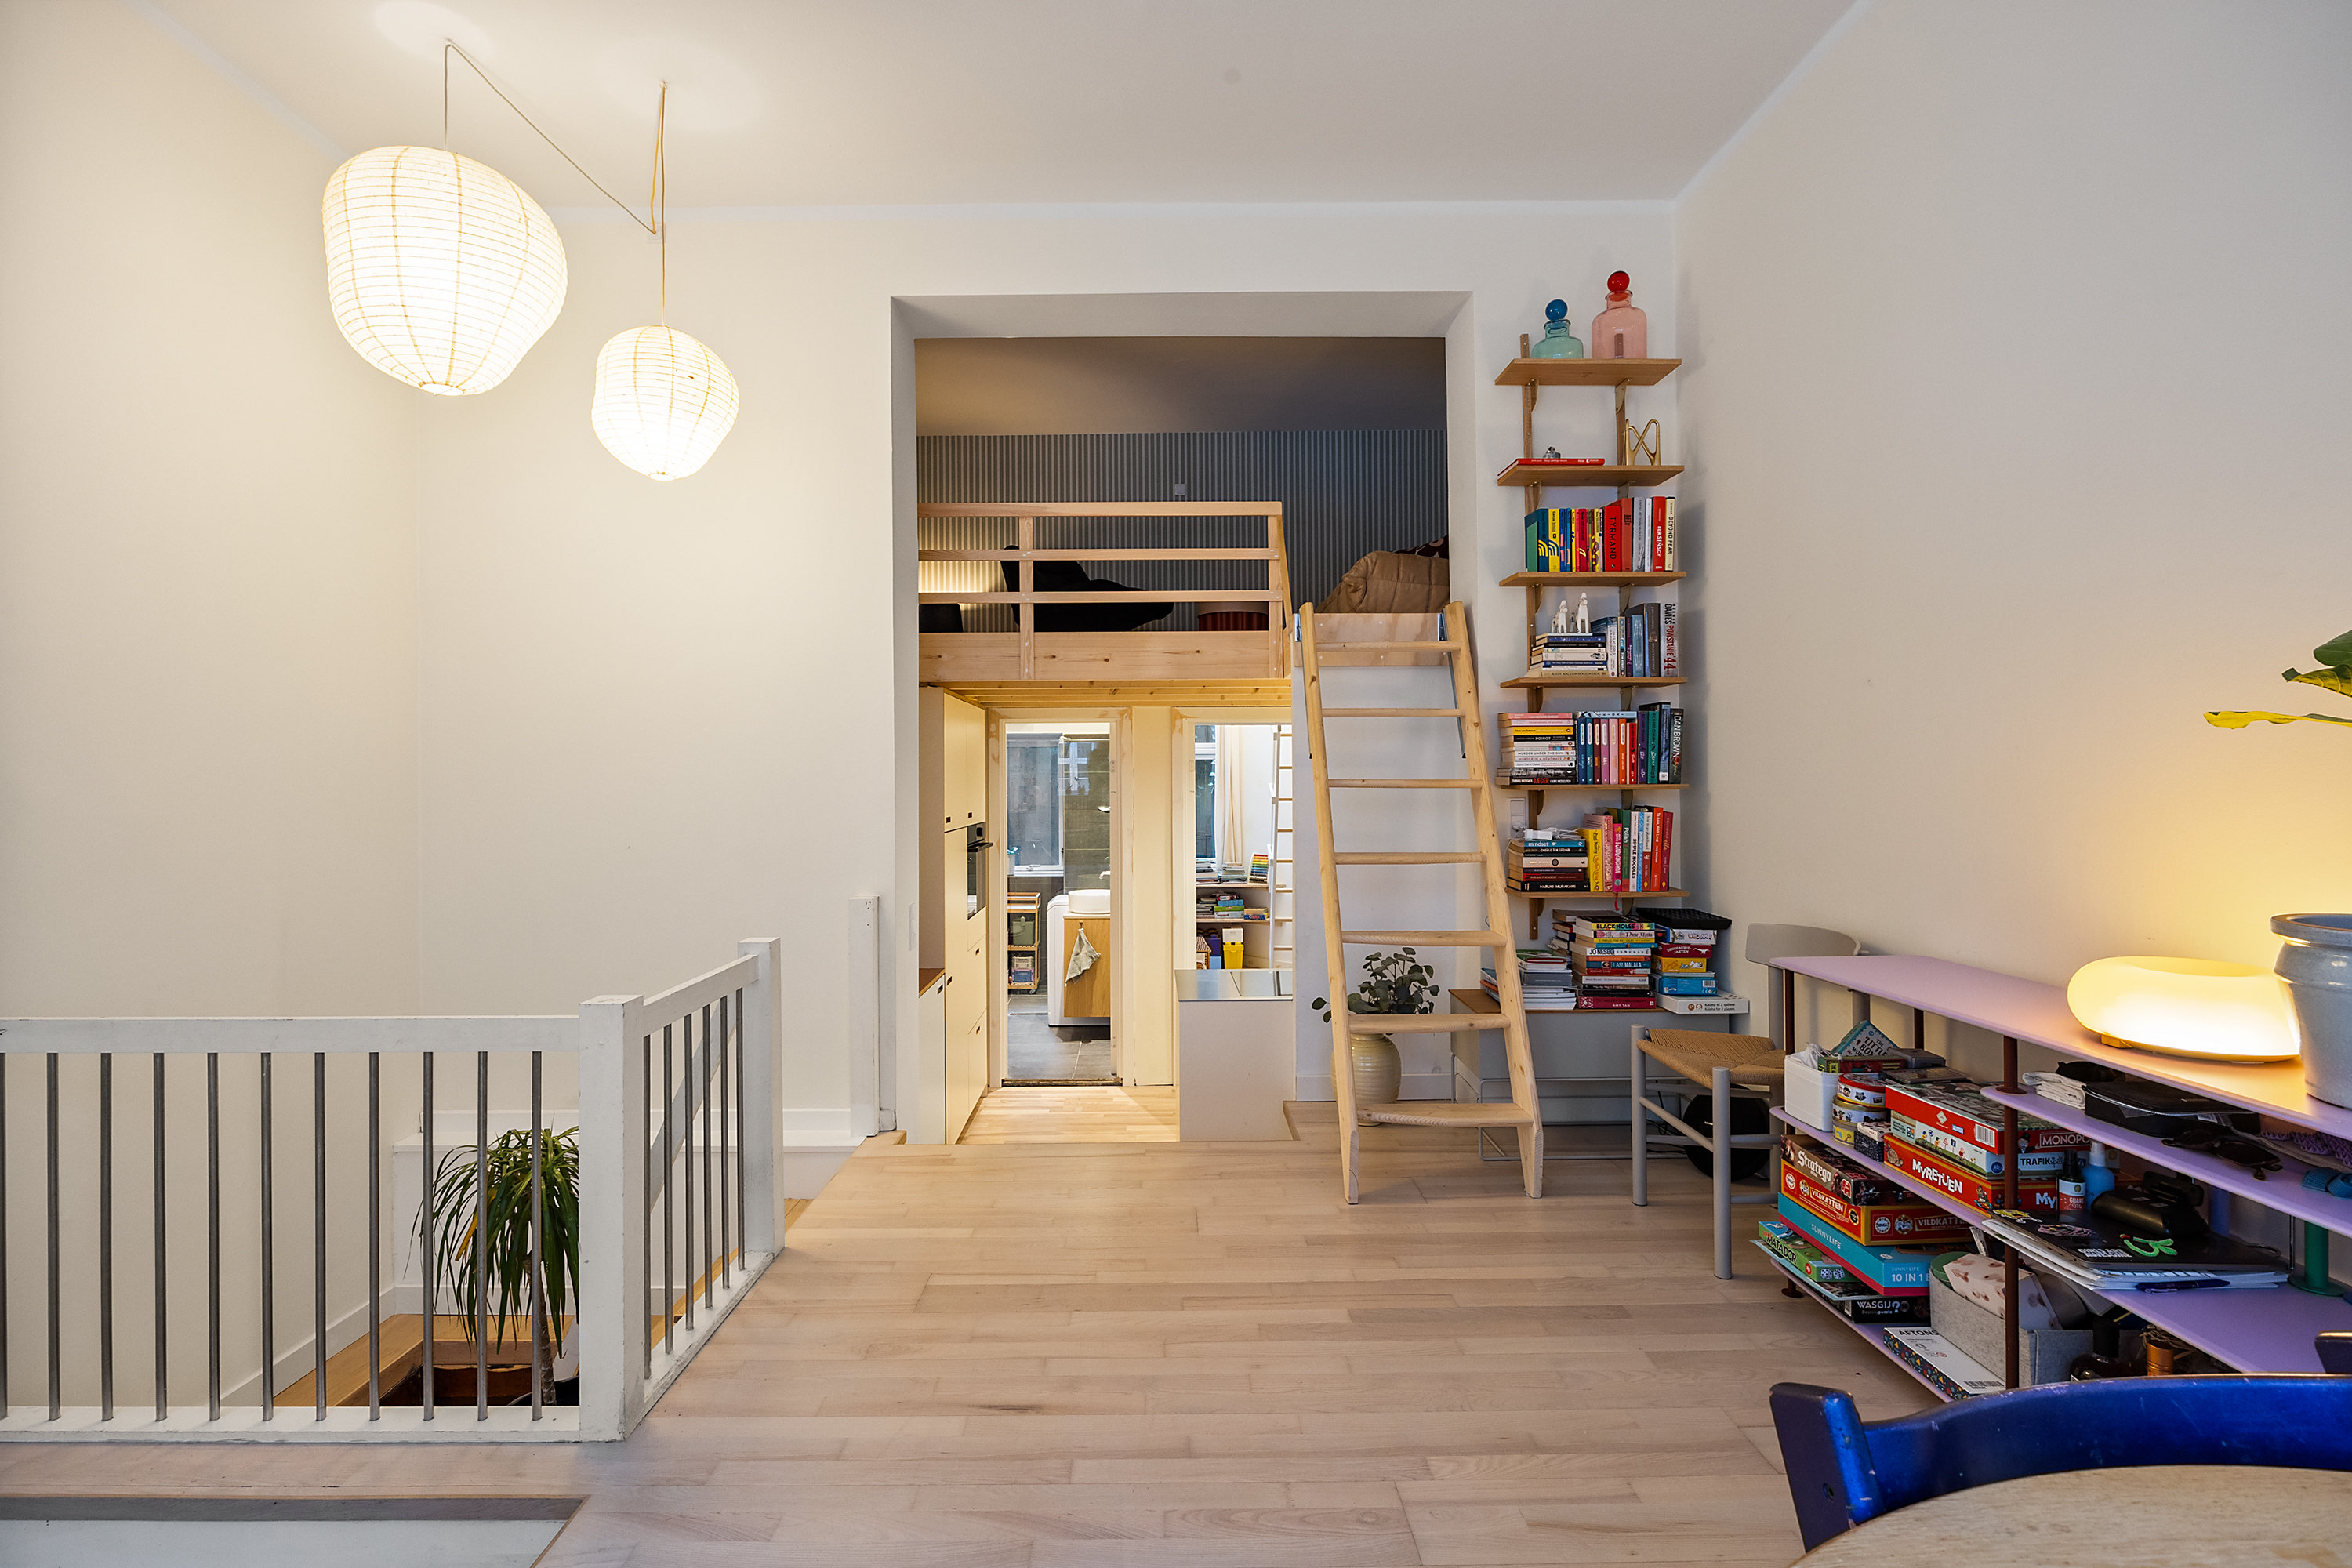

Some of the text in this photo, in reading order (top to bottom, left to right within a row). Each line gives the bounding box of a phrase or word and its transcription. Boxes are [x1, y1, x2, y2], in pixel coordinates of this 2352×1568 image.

[1664, 604, 1673, 625] DAVIES
[1666, 625, 1675, 656] POWSTANIE
[1672, 731, 1681, 758] BROWN
[1859, 1044, 1876, 1056] BOX
[1865, 1036, 1888, 1056] LITTLE
[1798, 1150, 1831, 1183] Stratego
[1811, 1189, 1844, 1213] VILDKATTEN
[1811, 1224, 1842, 1250] SUNNYLIFE
[1767, 1236, 1797, 1265] MATADOR
